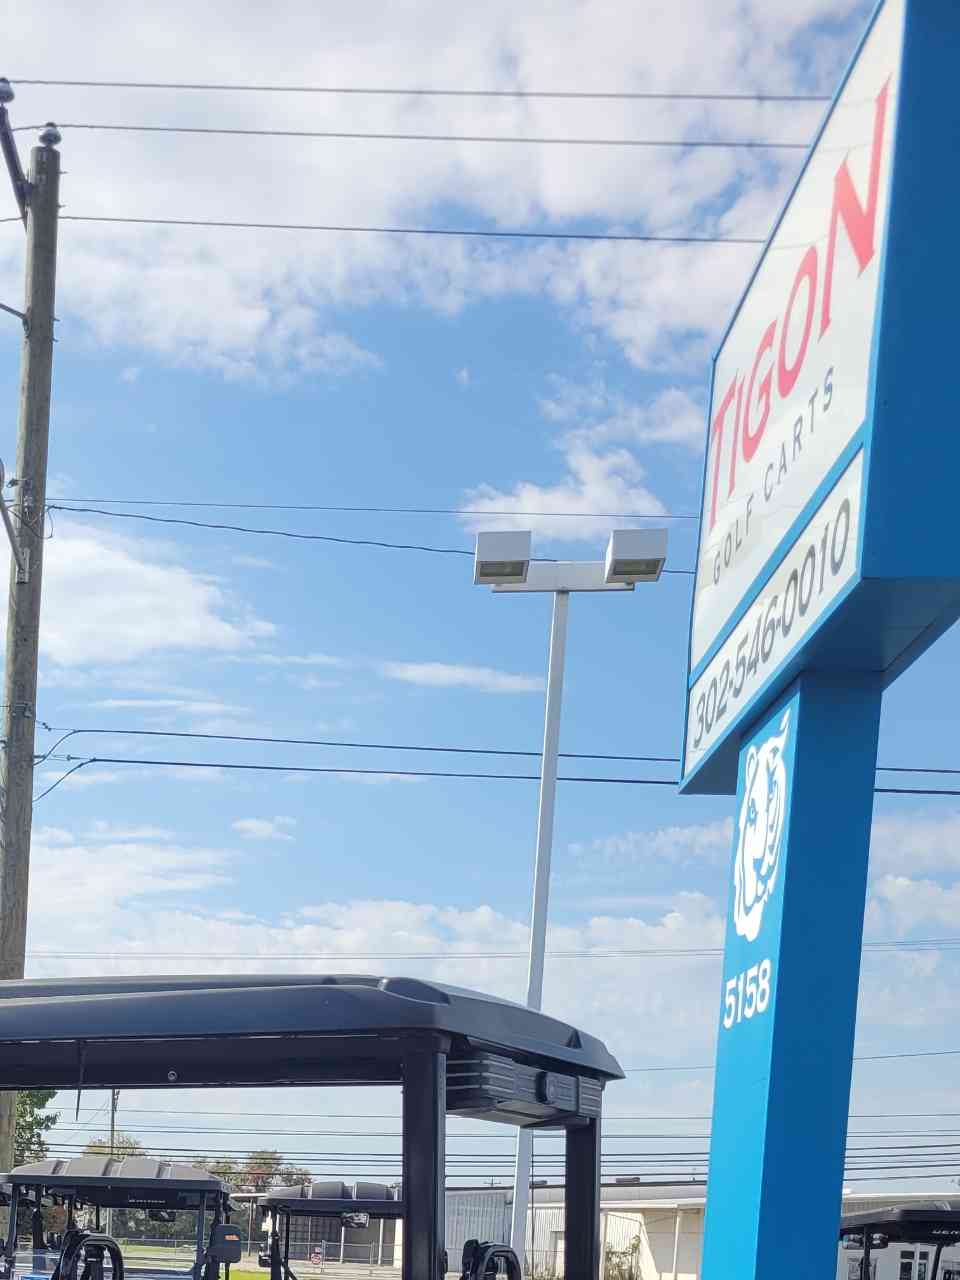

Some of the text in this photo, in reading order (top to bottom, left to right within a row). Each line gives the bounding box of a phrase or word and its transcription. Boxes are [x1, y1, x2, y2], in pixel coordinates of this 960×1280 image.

[709, 72, 892, 529] TIGON
[712, 366, 833, 586] GOLF CARTS
[692, 498, 850, 750] 302-546-0010
[723, 958, 771, 1029] 5158
